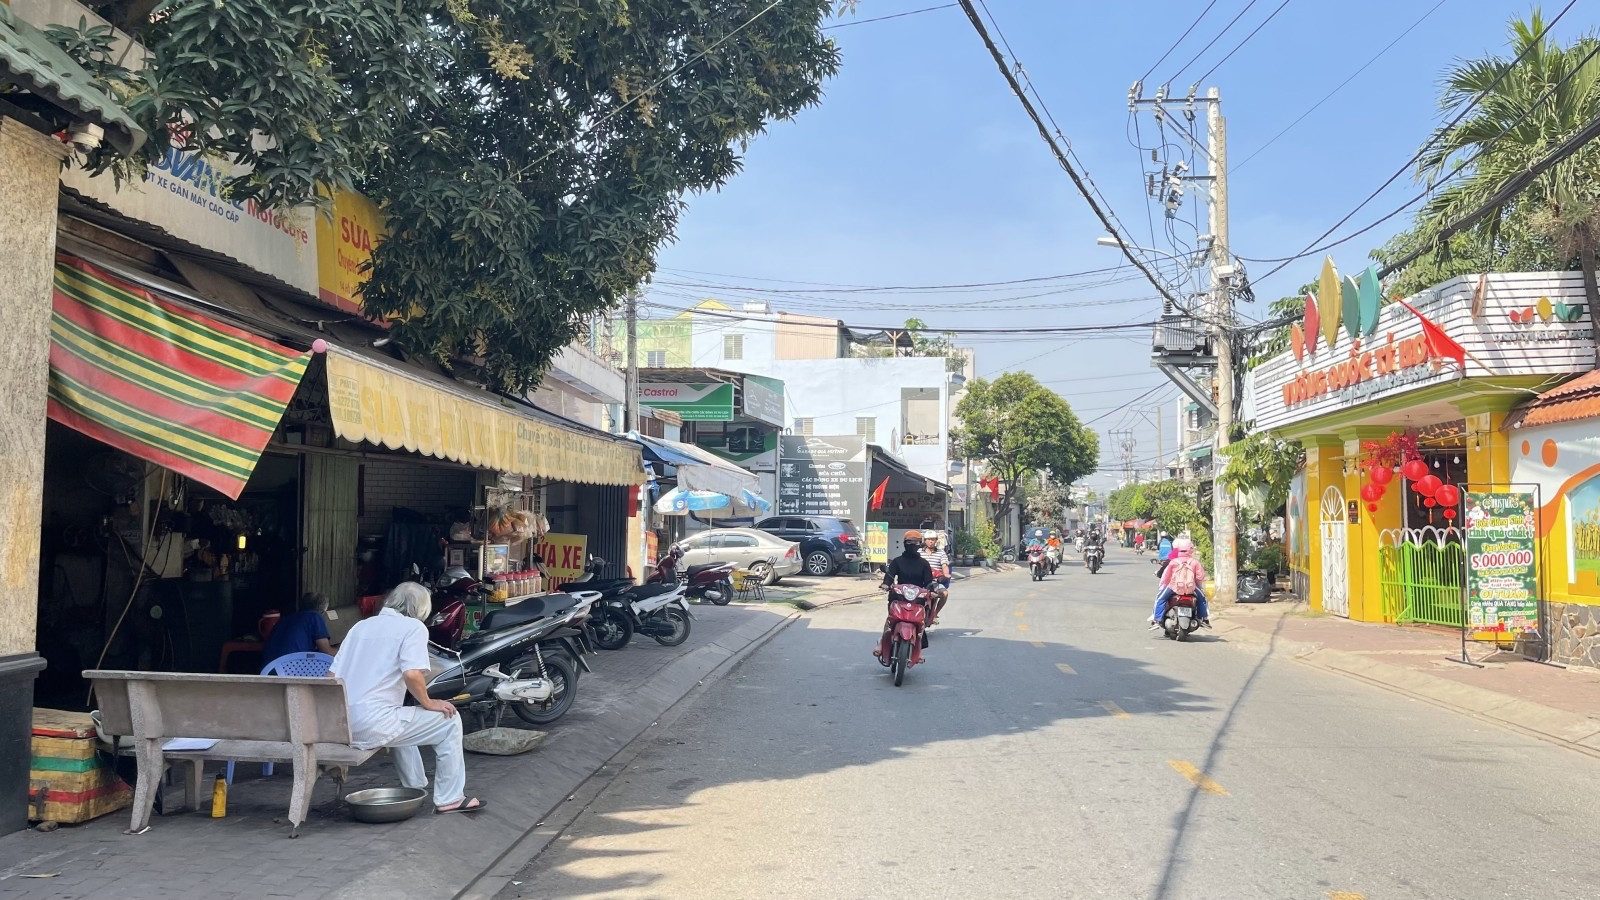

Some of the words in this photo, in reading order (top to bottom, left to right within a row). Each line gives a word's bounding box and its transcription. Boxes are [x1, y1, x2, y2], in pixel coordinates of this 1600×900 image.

[157, 175, 168, 189] XE
[208, 201, 224, 216] CAO
[643, 388, 678, 397] Castrol
[536, 536, 557, 568] ỬA
[561, 545, 583, 570] XE
[1472, 551, 1532, 568] 5.000.000
